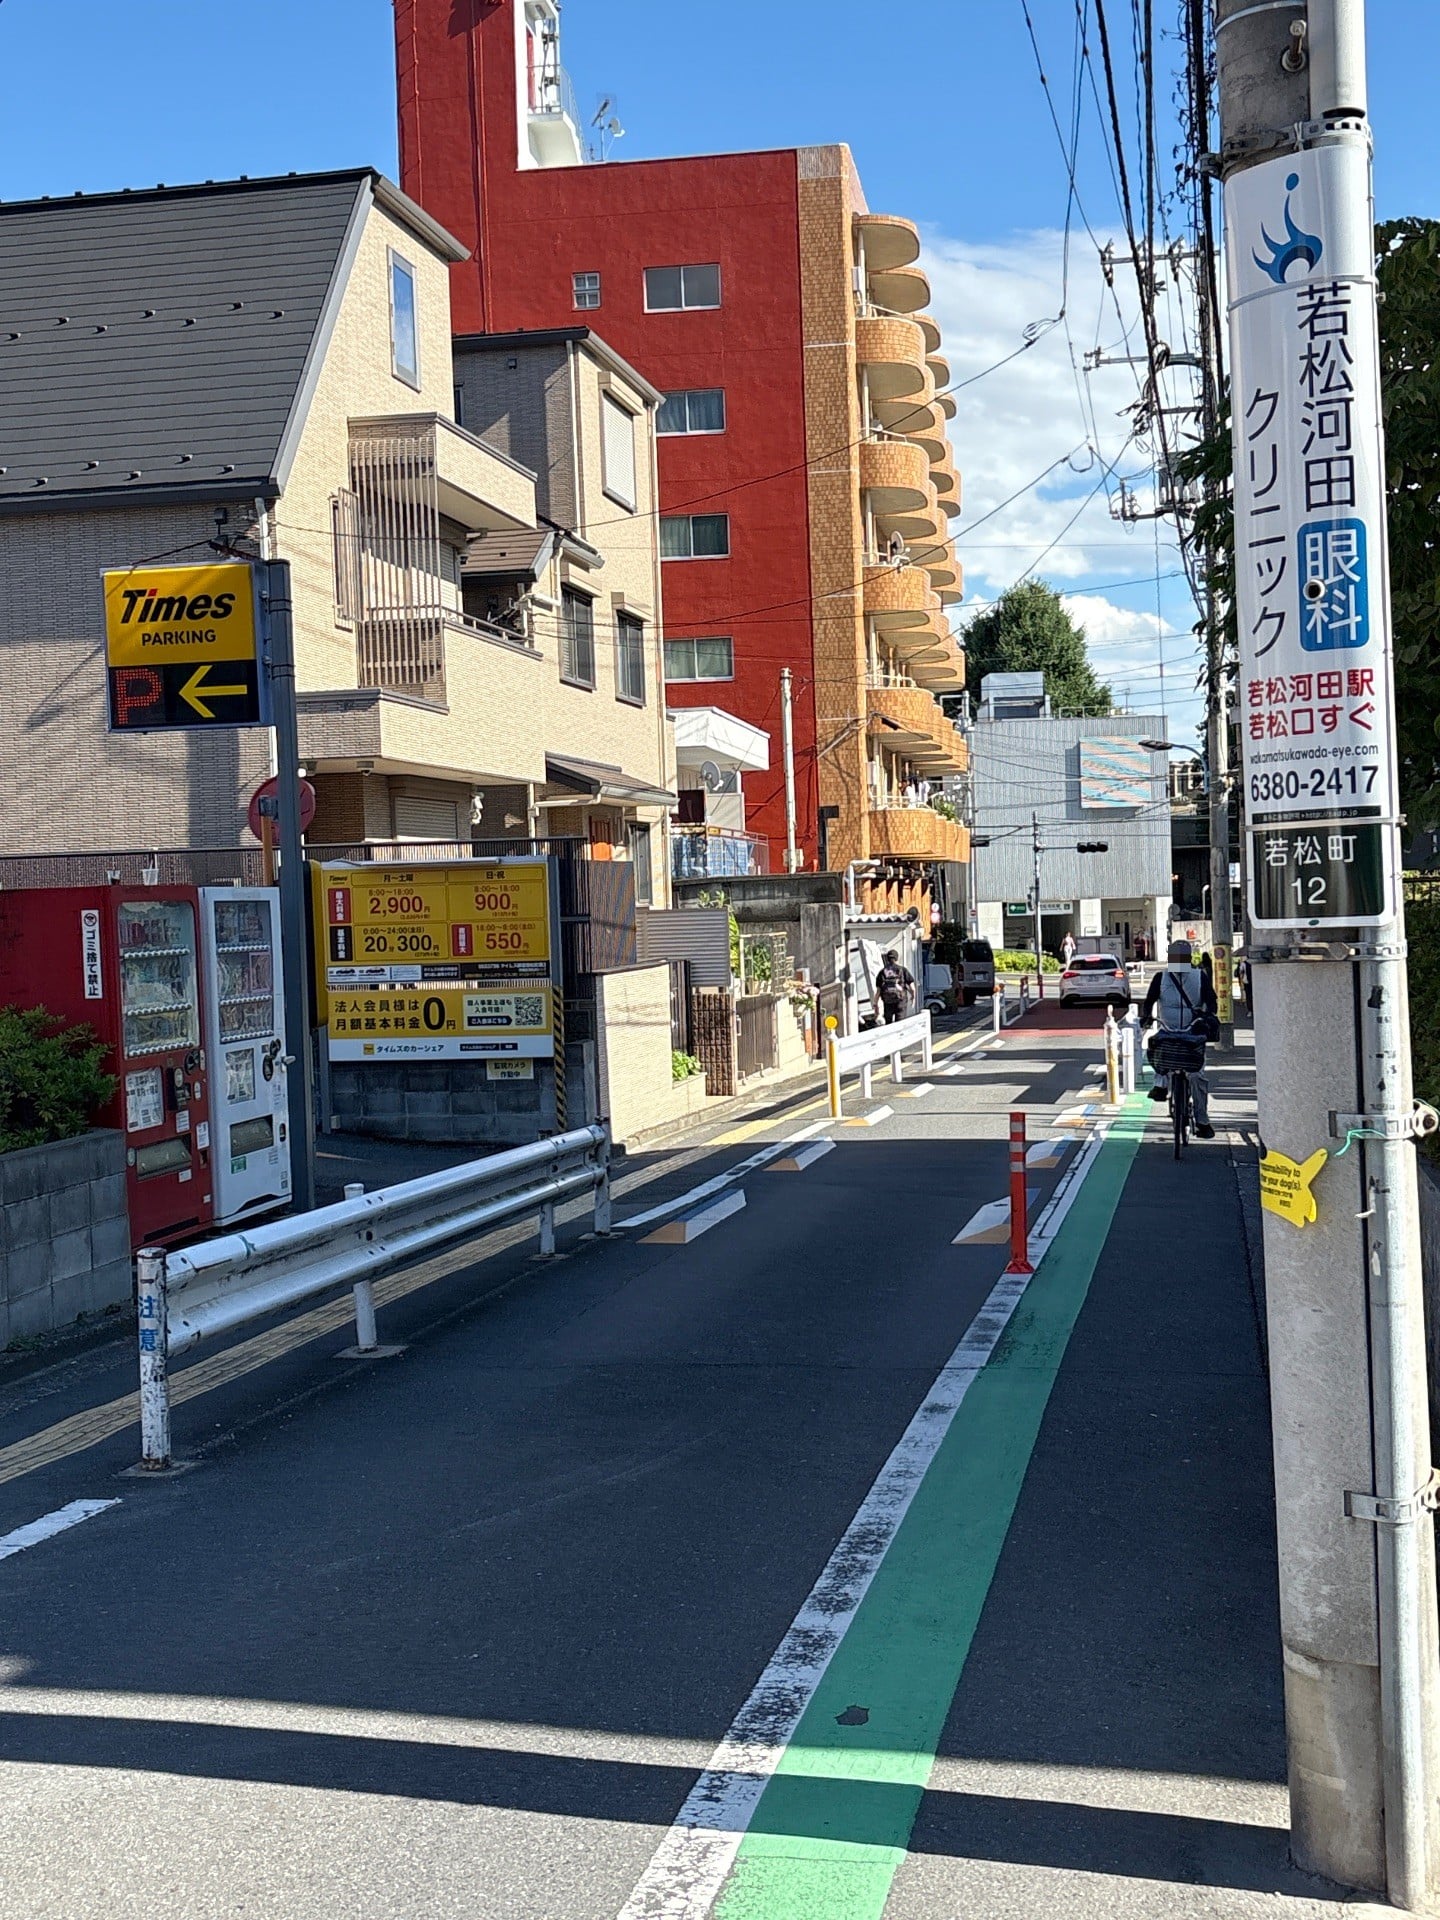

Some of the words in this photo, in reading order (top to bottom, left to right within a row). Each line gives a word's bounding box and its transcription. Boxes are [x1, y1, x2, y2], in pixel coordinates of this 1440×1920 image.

[1296, 281, 1356, 513] 若松河田
[1245, 388, 1287, 659] クリニック
[1304, 528, 1363, 645] 眼科
[120, 588, 236, 624] Times
[141, 629, 217, 646] PARKING
[115, 668, 162, 725] P
[1247, 668, 1375, 708] 若松河田駅
[1248, 702, 1376, 741] 若松口すぐ
[1249, 744, 1379, 765] wakamatsukawada-eye.com
[1250, 765, 1379, 802] 6380-2417
[1264, 834, 1358, 867] 若松町
[1290, 876, 1327, 906] 12
[85, 929, 100, 997] ゴミ捨て禁止
[334, 999, 420, 1013] 法人会員様は
[335, 1016, 420, 1031] 月額基本料金
[376, 1044, 445, 1054] タイムズのカーシェア
[139, 1295, 159, 1352] 注意
